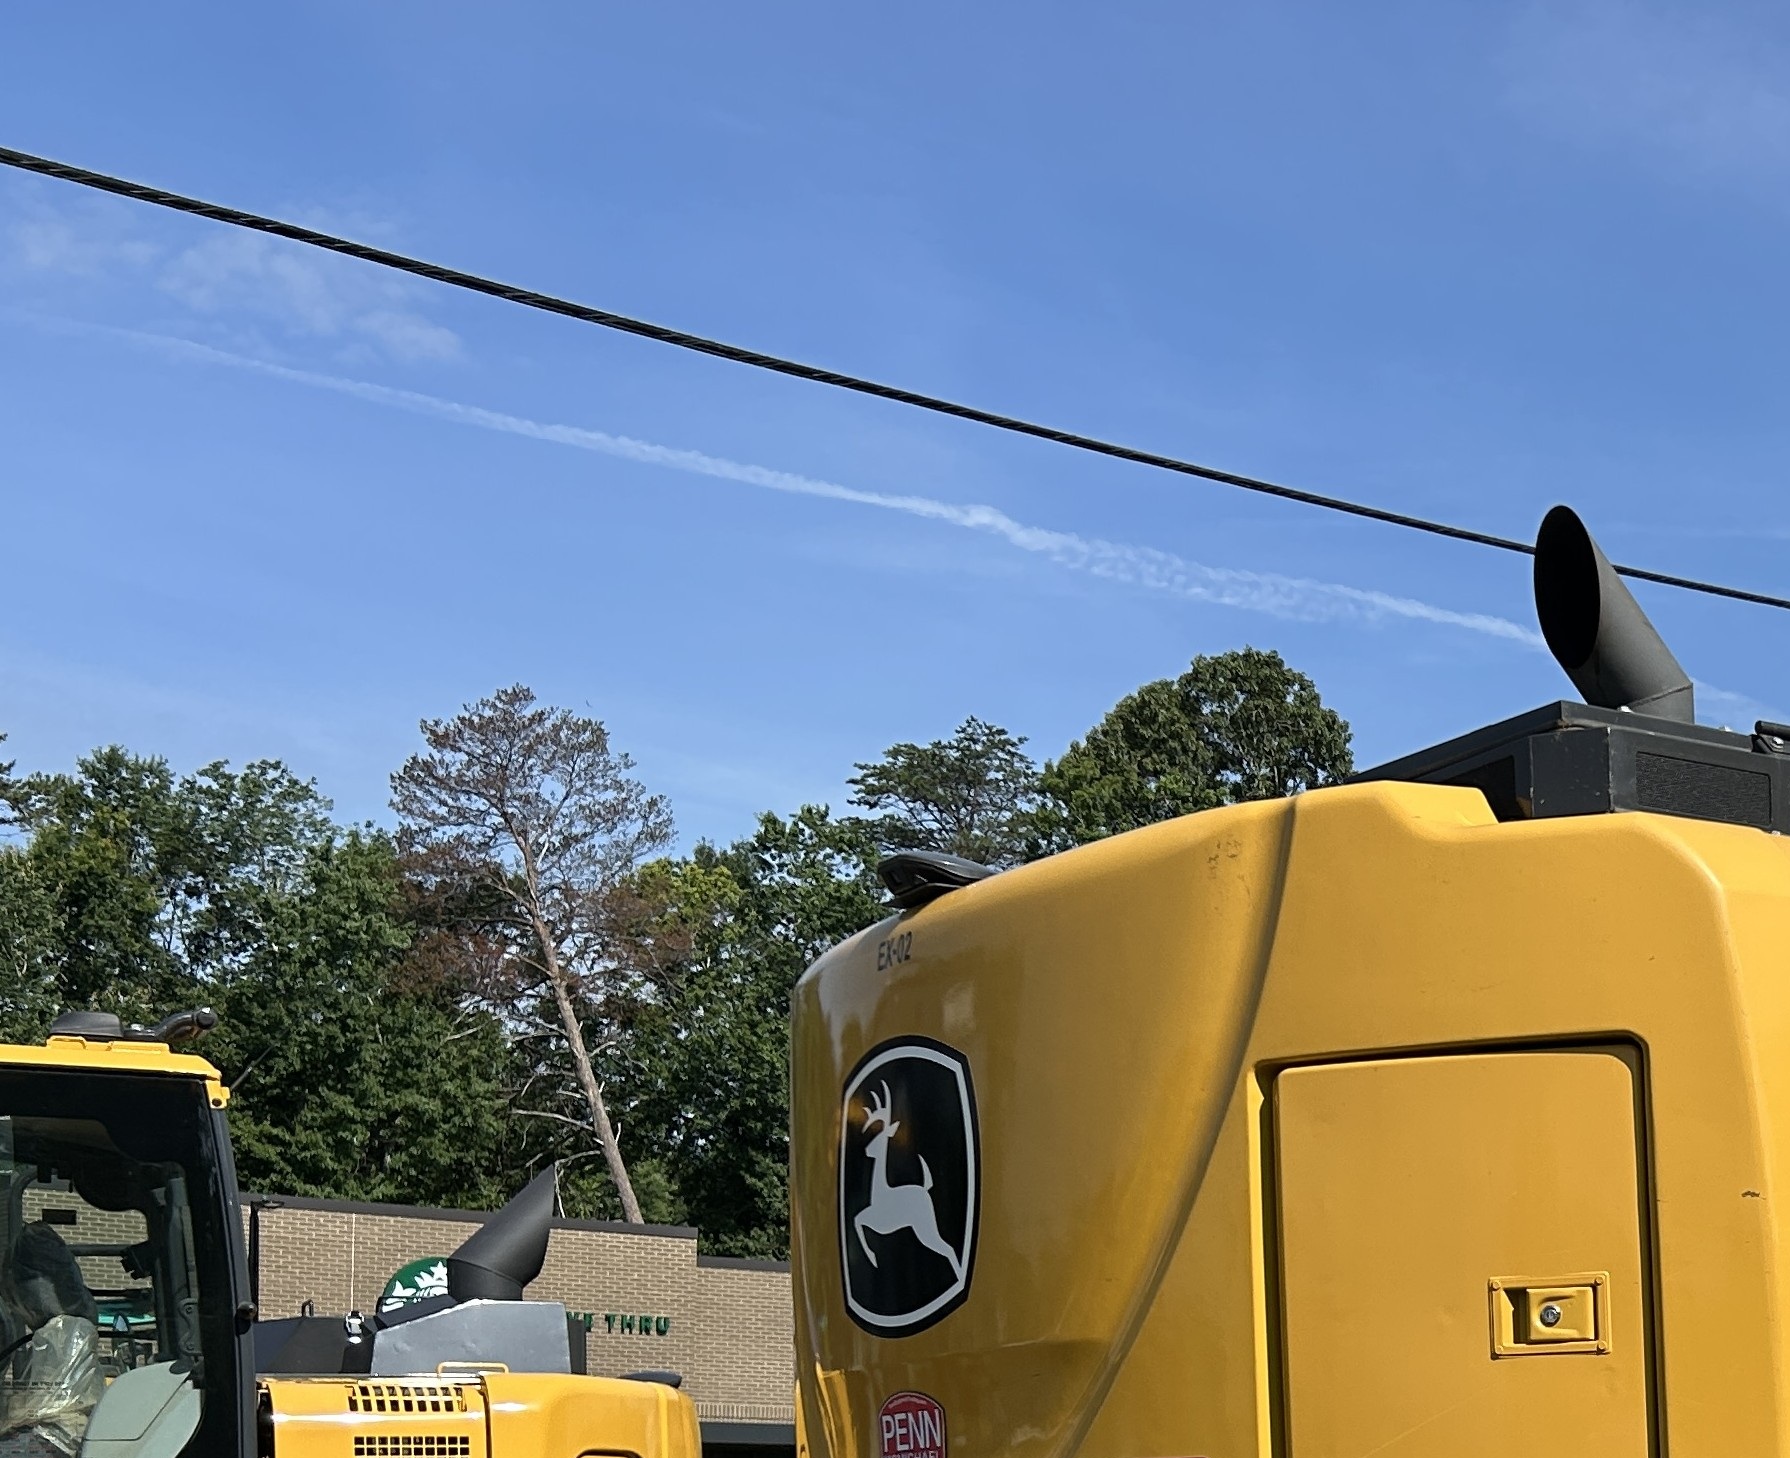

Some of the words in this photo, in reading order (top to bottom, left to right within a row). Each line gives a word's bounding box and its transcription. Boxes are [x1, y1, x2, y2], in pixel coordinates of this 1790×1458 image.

[877, 931, 913, 971] EX-02
[604, 1313, 670, 1336] THRU
[881, 1408, 942, 1453] PENN
